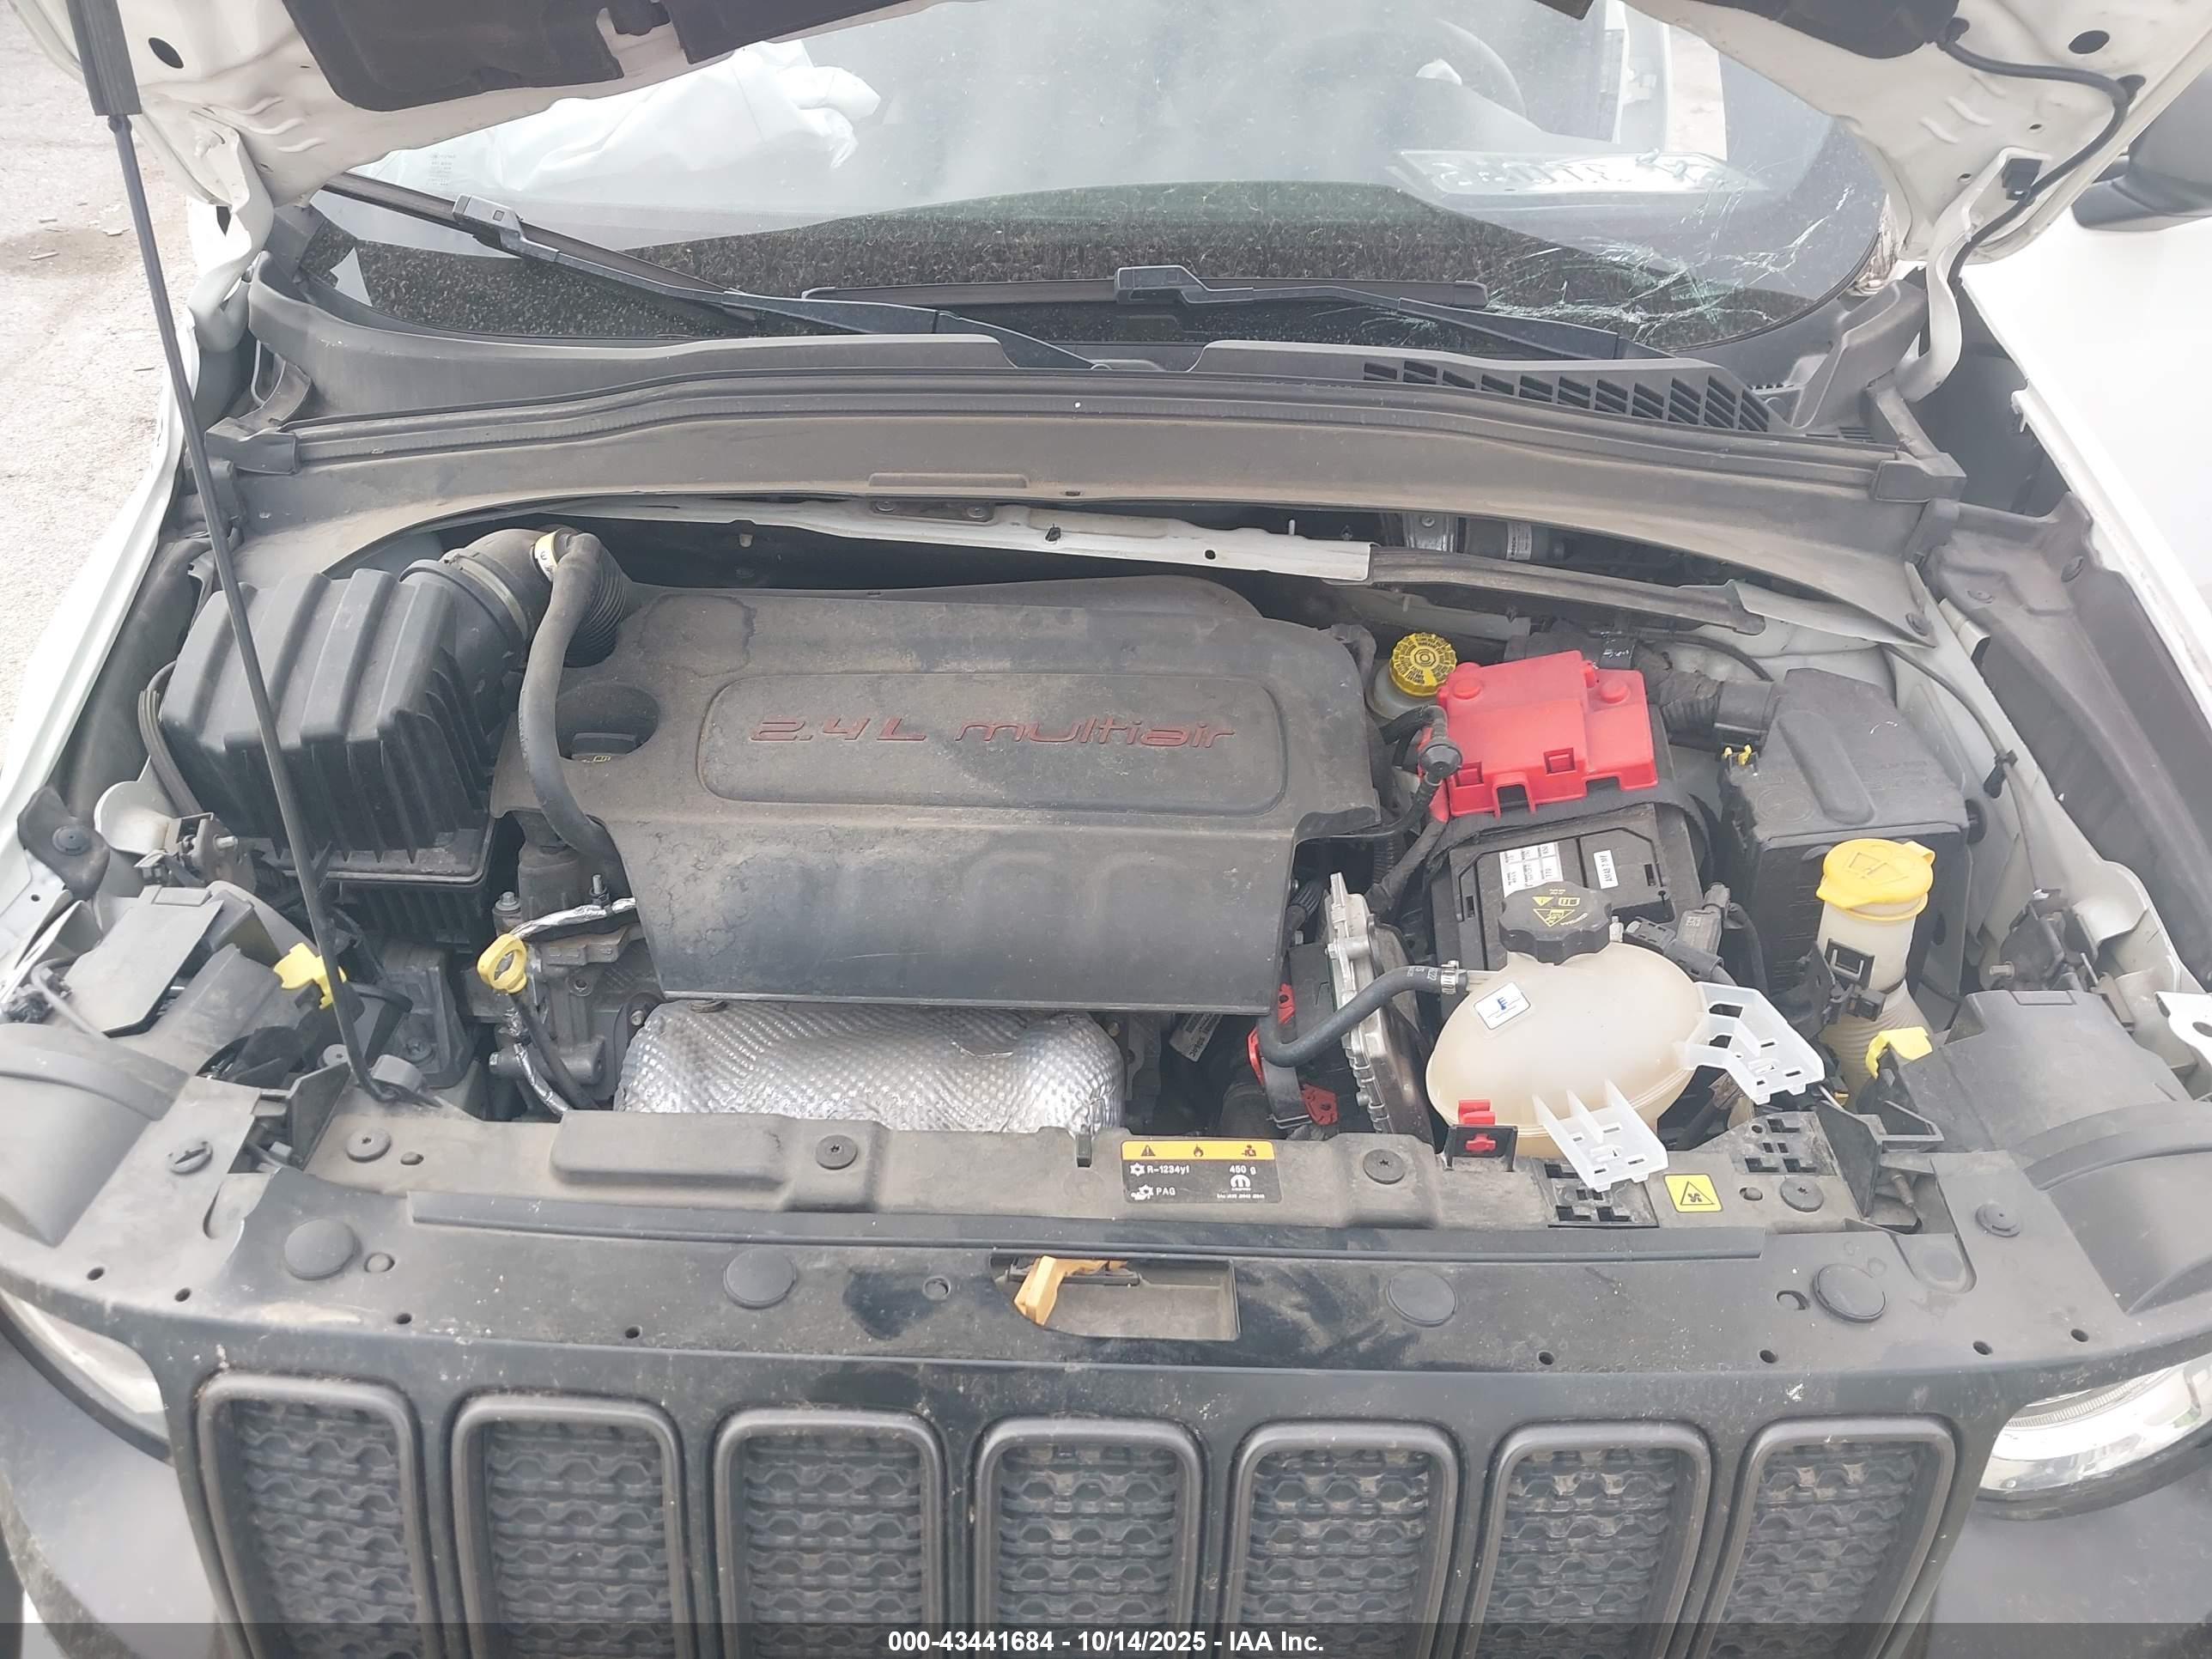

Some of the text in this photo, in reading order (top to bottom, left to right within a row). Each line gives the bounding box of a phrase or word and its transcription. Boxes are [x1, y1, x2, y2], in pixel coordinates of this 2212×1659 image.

[749, 715, 1236, 749] 2.4 L multiair
[1229, 1164, 1257, 1176] 450 g
[1156, 1187, 1176, 1196] PAG
